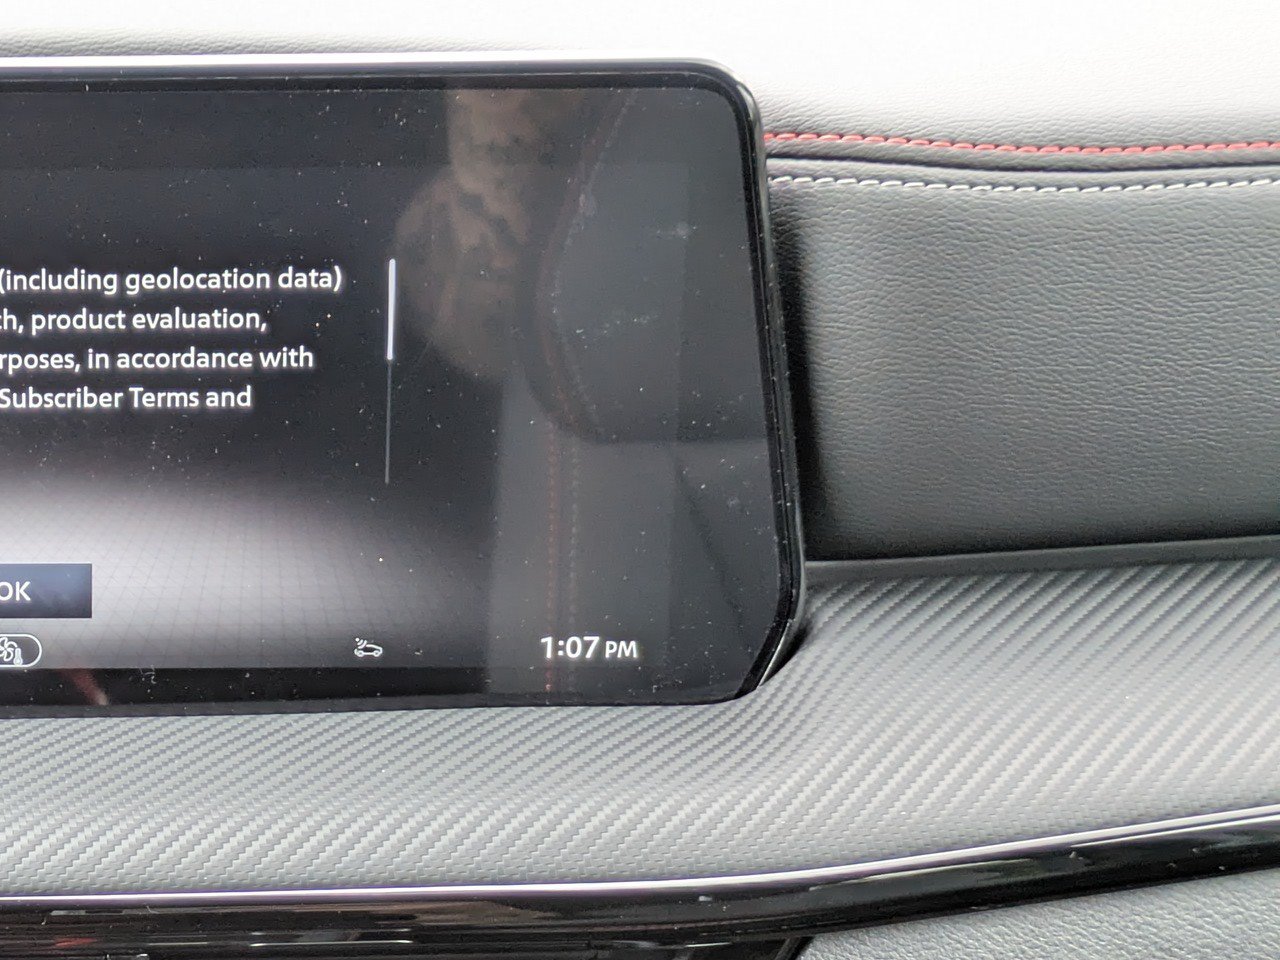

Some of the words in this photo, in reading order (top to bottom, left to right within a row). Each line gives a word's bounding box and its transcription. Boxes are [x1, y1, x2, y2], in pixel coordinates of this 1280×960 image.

[125, 266, 271, 296] geolocation
[277, 265, 343, 292] data)
[31, 307, 127, 336] product
[131, 306, 267, 332] evaluation,
[87, 348, 110, 370] in
[116, 345, 254, 369] accordance
[259, 344, 314, 368] with
[128, 387, 200, 408] Terms
[205, 384, 252, 408] and
[540, 635, 599, 659] 1:07
[604, 640, 638, 659] PM
